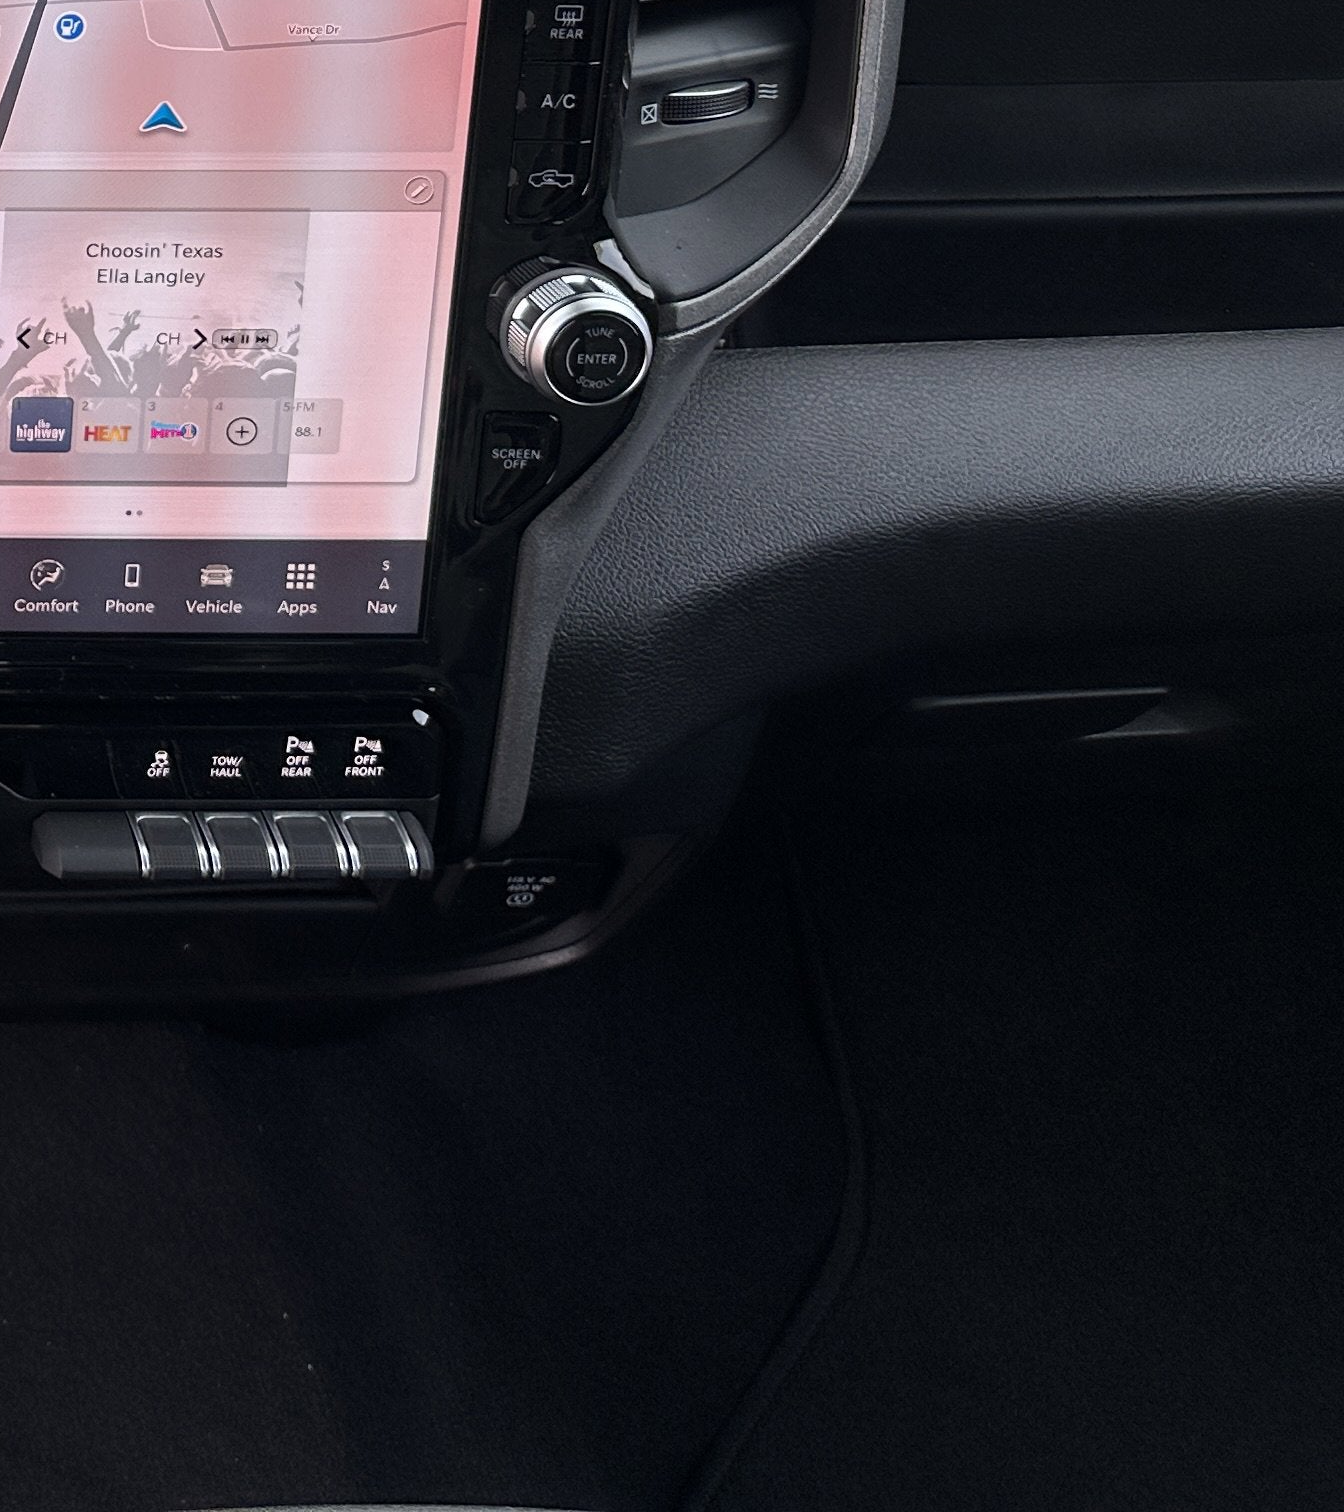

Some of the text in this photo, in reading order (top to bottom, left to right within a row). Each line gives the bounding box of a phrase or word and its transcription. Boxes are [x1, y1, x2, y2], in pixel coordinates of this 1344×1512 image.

[288, 24, 340, 35] Vance Dr
[550, 28, 584, 39] REAR
[541, 94, 576, 109] A/C
[86, 243, 223, 259] Choosin' Texas
[97, 269, 205, 287] Ella Langley
[43, 332, 67, 345] CH
[156, 332, 180, 345] CH
[585, 327, 615, 338] TUNE
[577, 353, 617, 365] ENTER
[576, 375, 616, 389] SCROLL
[16, 424, 66, 442] highway
[84, 426, 132, 442] HEAT
[295, 427, 321, 437] 88.1
[492, 449, 541, 459] SCREEN
[503, 460, 528, 470] OFF
[14, 598, 79, 614] Comfort
[105, 598, 155, 614] Phone
[186, 599, 243, 615] Vehicle
[277, 600, 318, 618] Apps
[367, 600, 398, 615] Nav
[212, 756, 243, 766] TOW/
[286, 756, 309, 765] OFF
[354, 755, 377, 765] OFF
[147, 767, 170, 777] OFF
[210, 767, 241, 777] HAUL
[281, 767, 312, 777] REAR
[345, 766, 384, 777] FRONT
